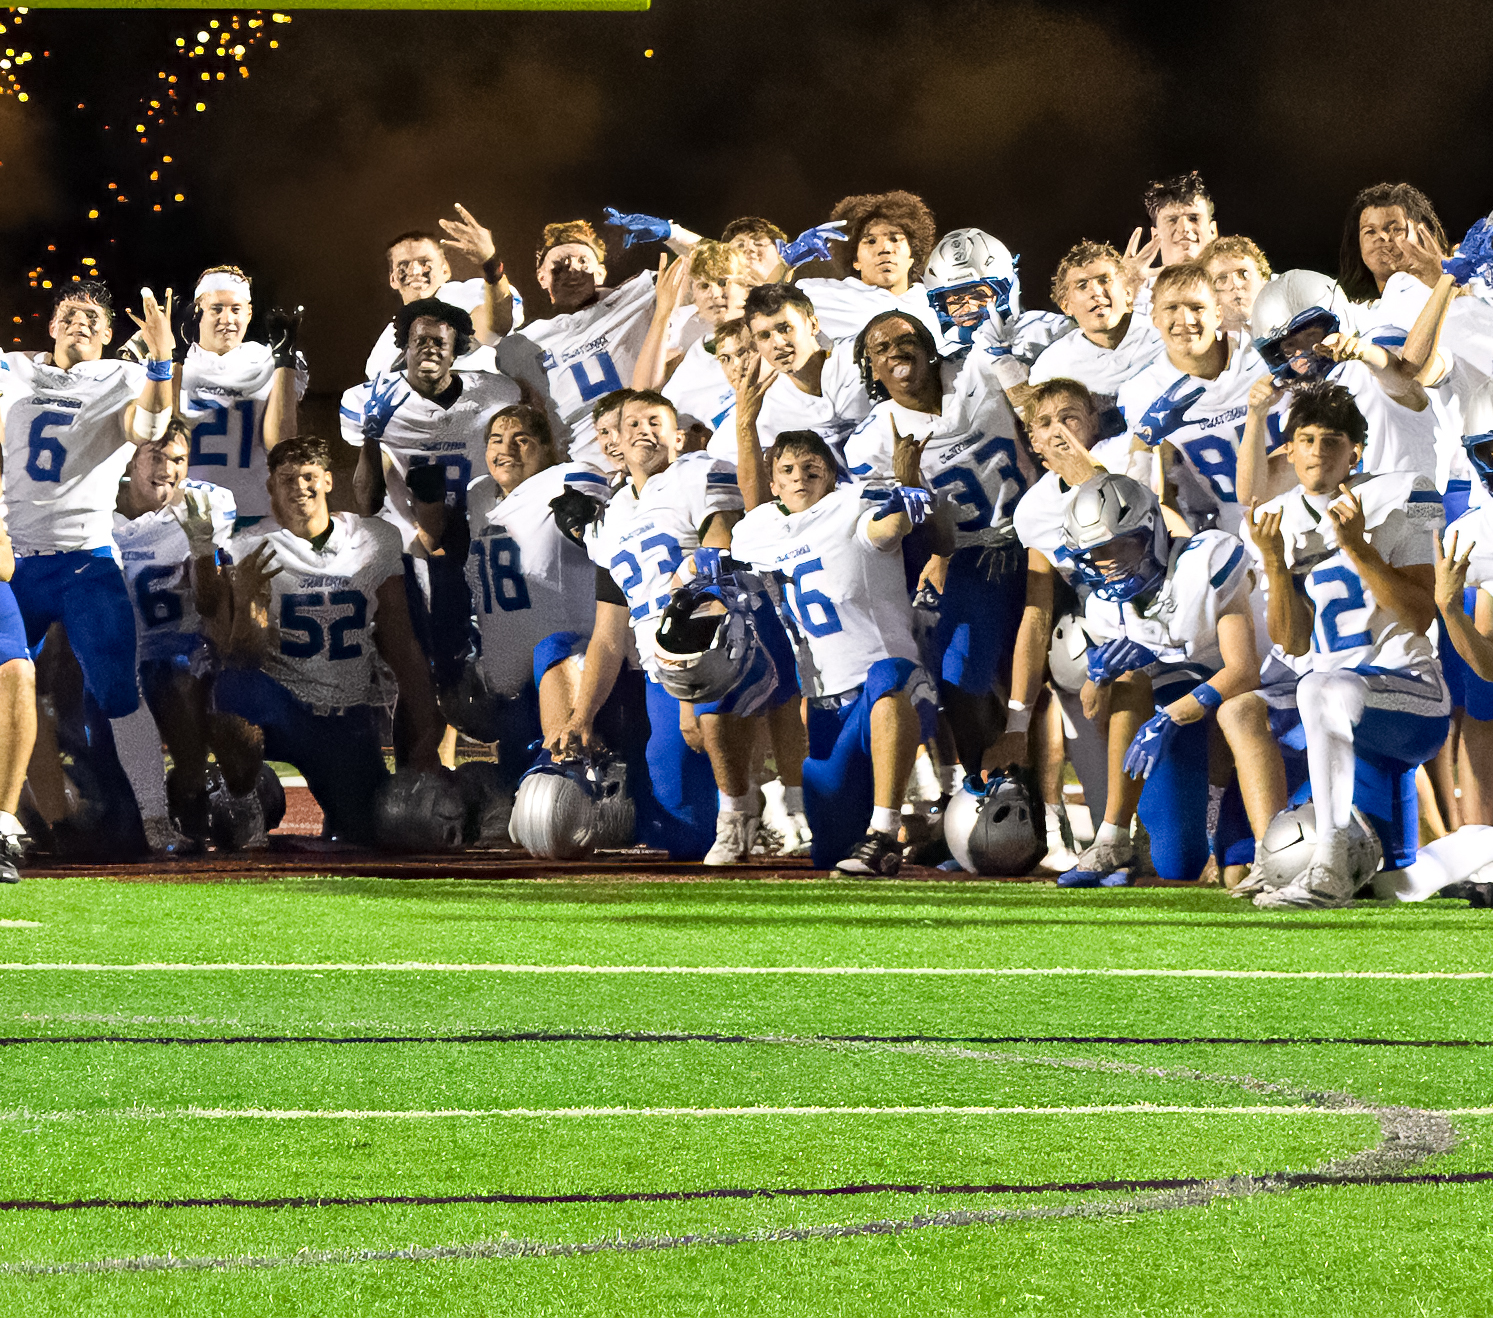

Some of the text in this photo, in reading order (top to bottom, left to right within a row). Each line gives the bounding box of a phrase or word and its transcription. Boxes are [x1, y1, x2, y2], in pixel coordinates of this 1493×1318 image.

[26, 410, 76, 483] 6
[188, 399, 255, 469] 21
[280, 590, 368, 662] 52
